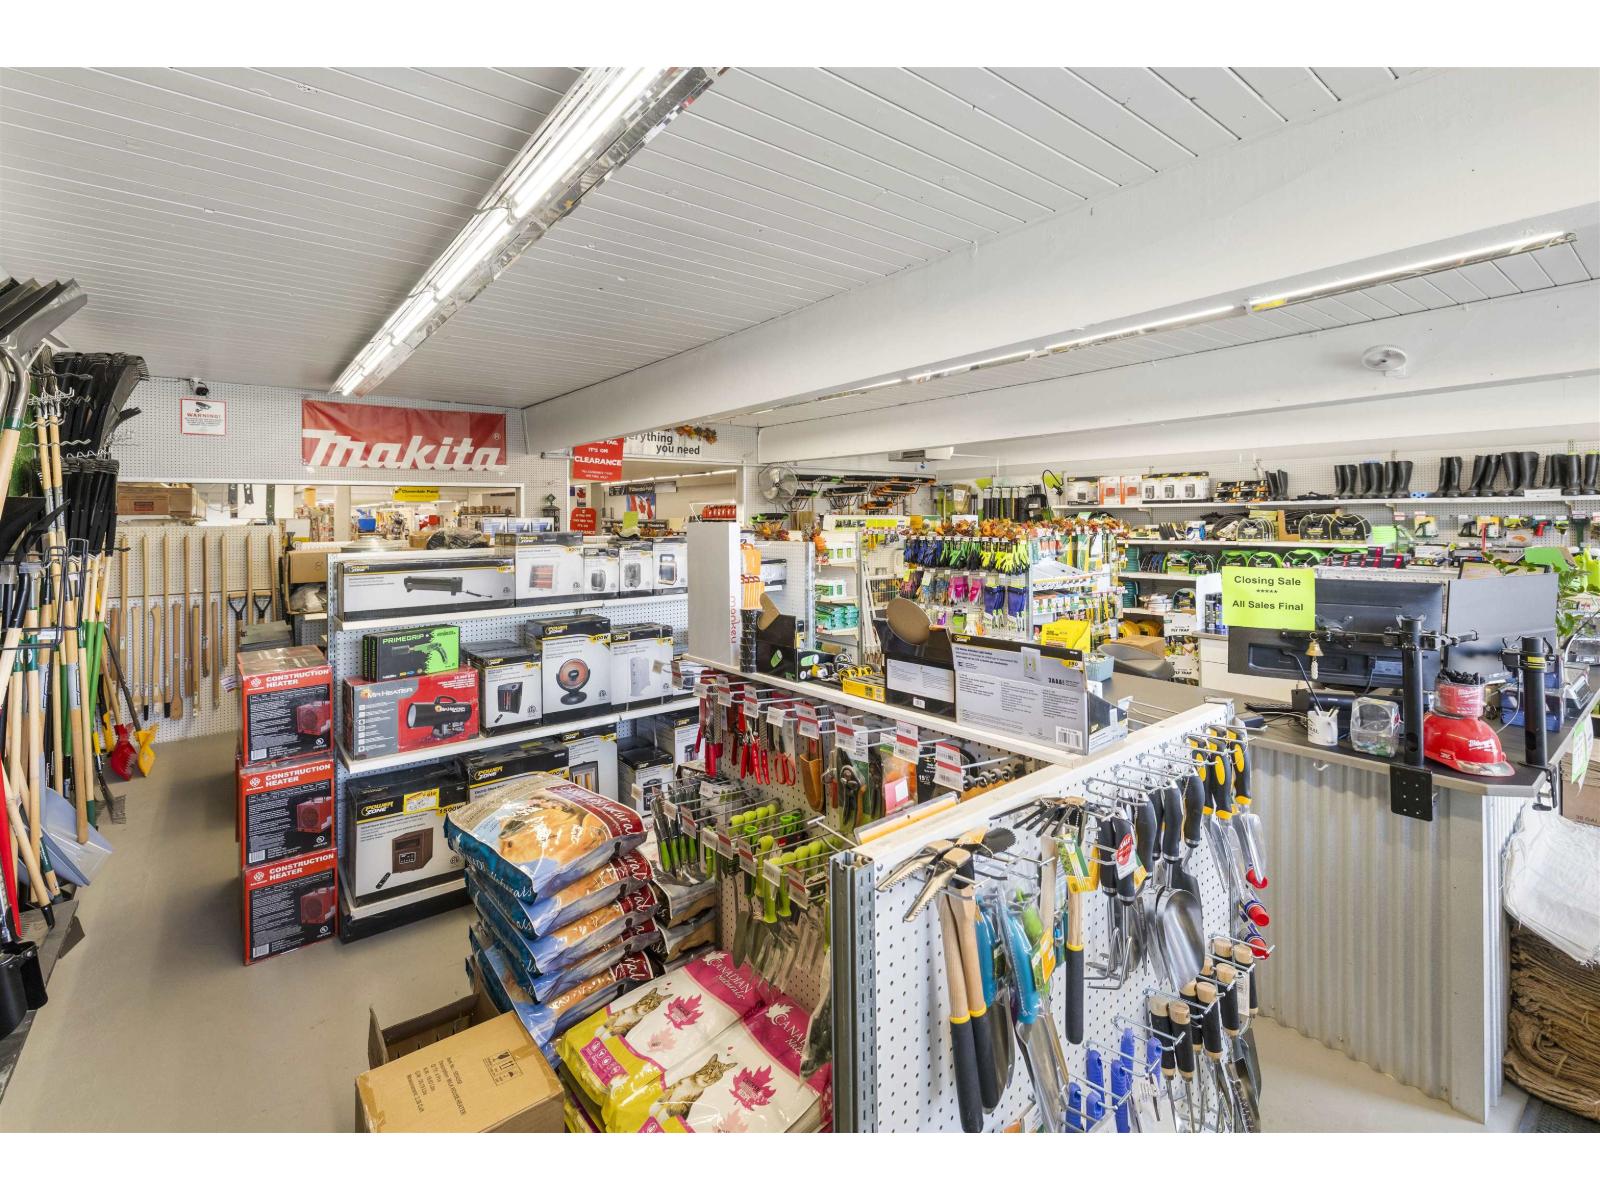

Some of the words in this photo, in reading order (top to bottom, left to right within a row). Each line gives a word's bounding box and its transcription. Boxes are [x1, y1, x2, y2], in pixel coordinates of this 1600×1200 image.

[656, 444, 675, 455] you
[677, 445, 700, 455] need
[574, 456, 622, 467] CLEARANCE
[1234, 575, 1275, 587] Closing
[1277, 577, 1302, 586] Sale
[1232, 600, 1245, 608] All
[1248, 601, 1275, 610] Sales
[1278, 602, 1304, 611] Final
[382, 633, 425, 645] PRIMEGRIP
[266, 670, 329, 682] CONSTRUCTION
[266, 679, 299, 688] HEATER
[265, 763, 331, 781] CONSTRUCTION
[265, 776, 299, 788] HEATER
[366, 801, 394, 812] POWER
[269, 853, 334, 874] CONSTRUCTION
[269, 868, 303, 881] HEATER
[711, 958, 753, 994] CANADIAN
